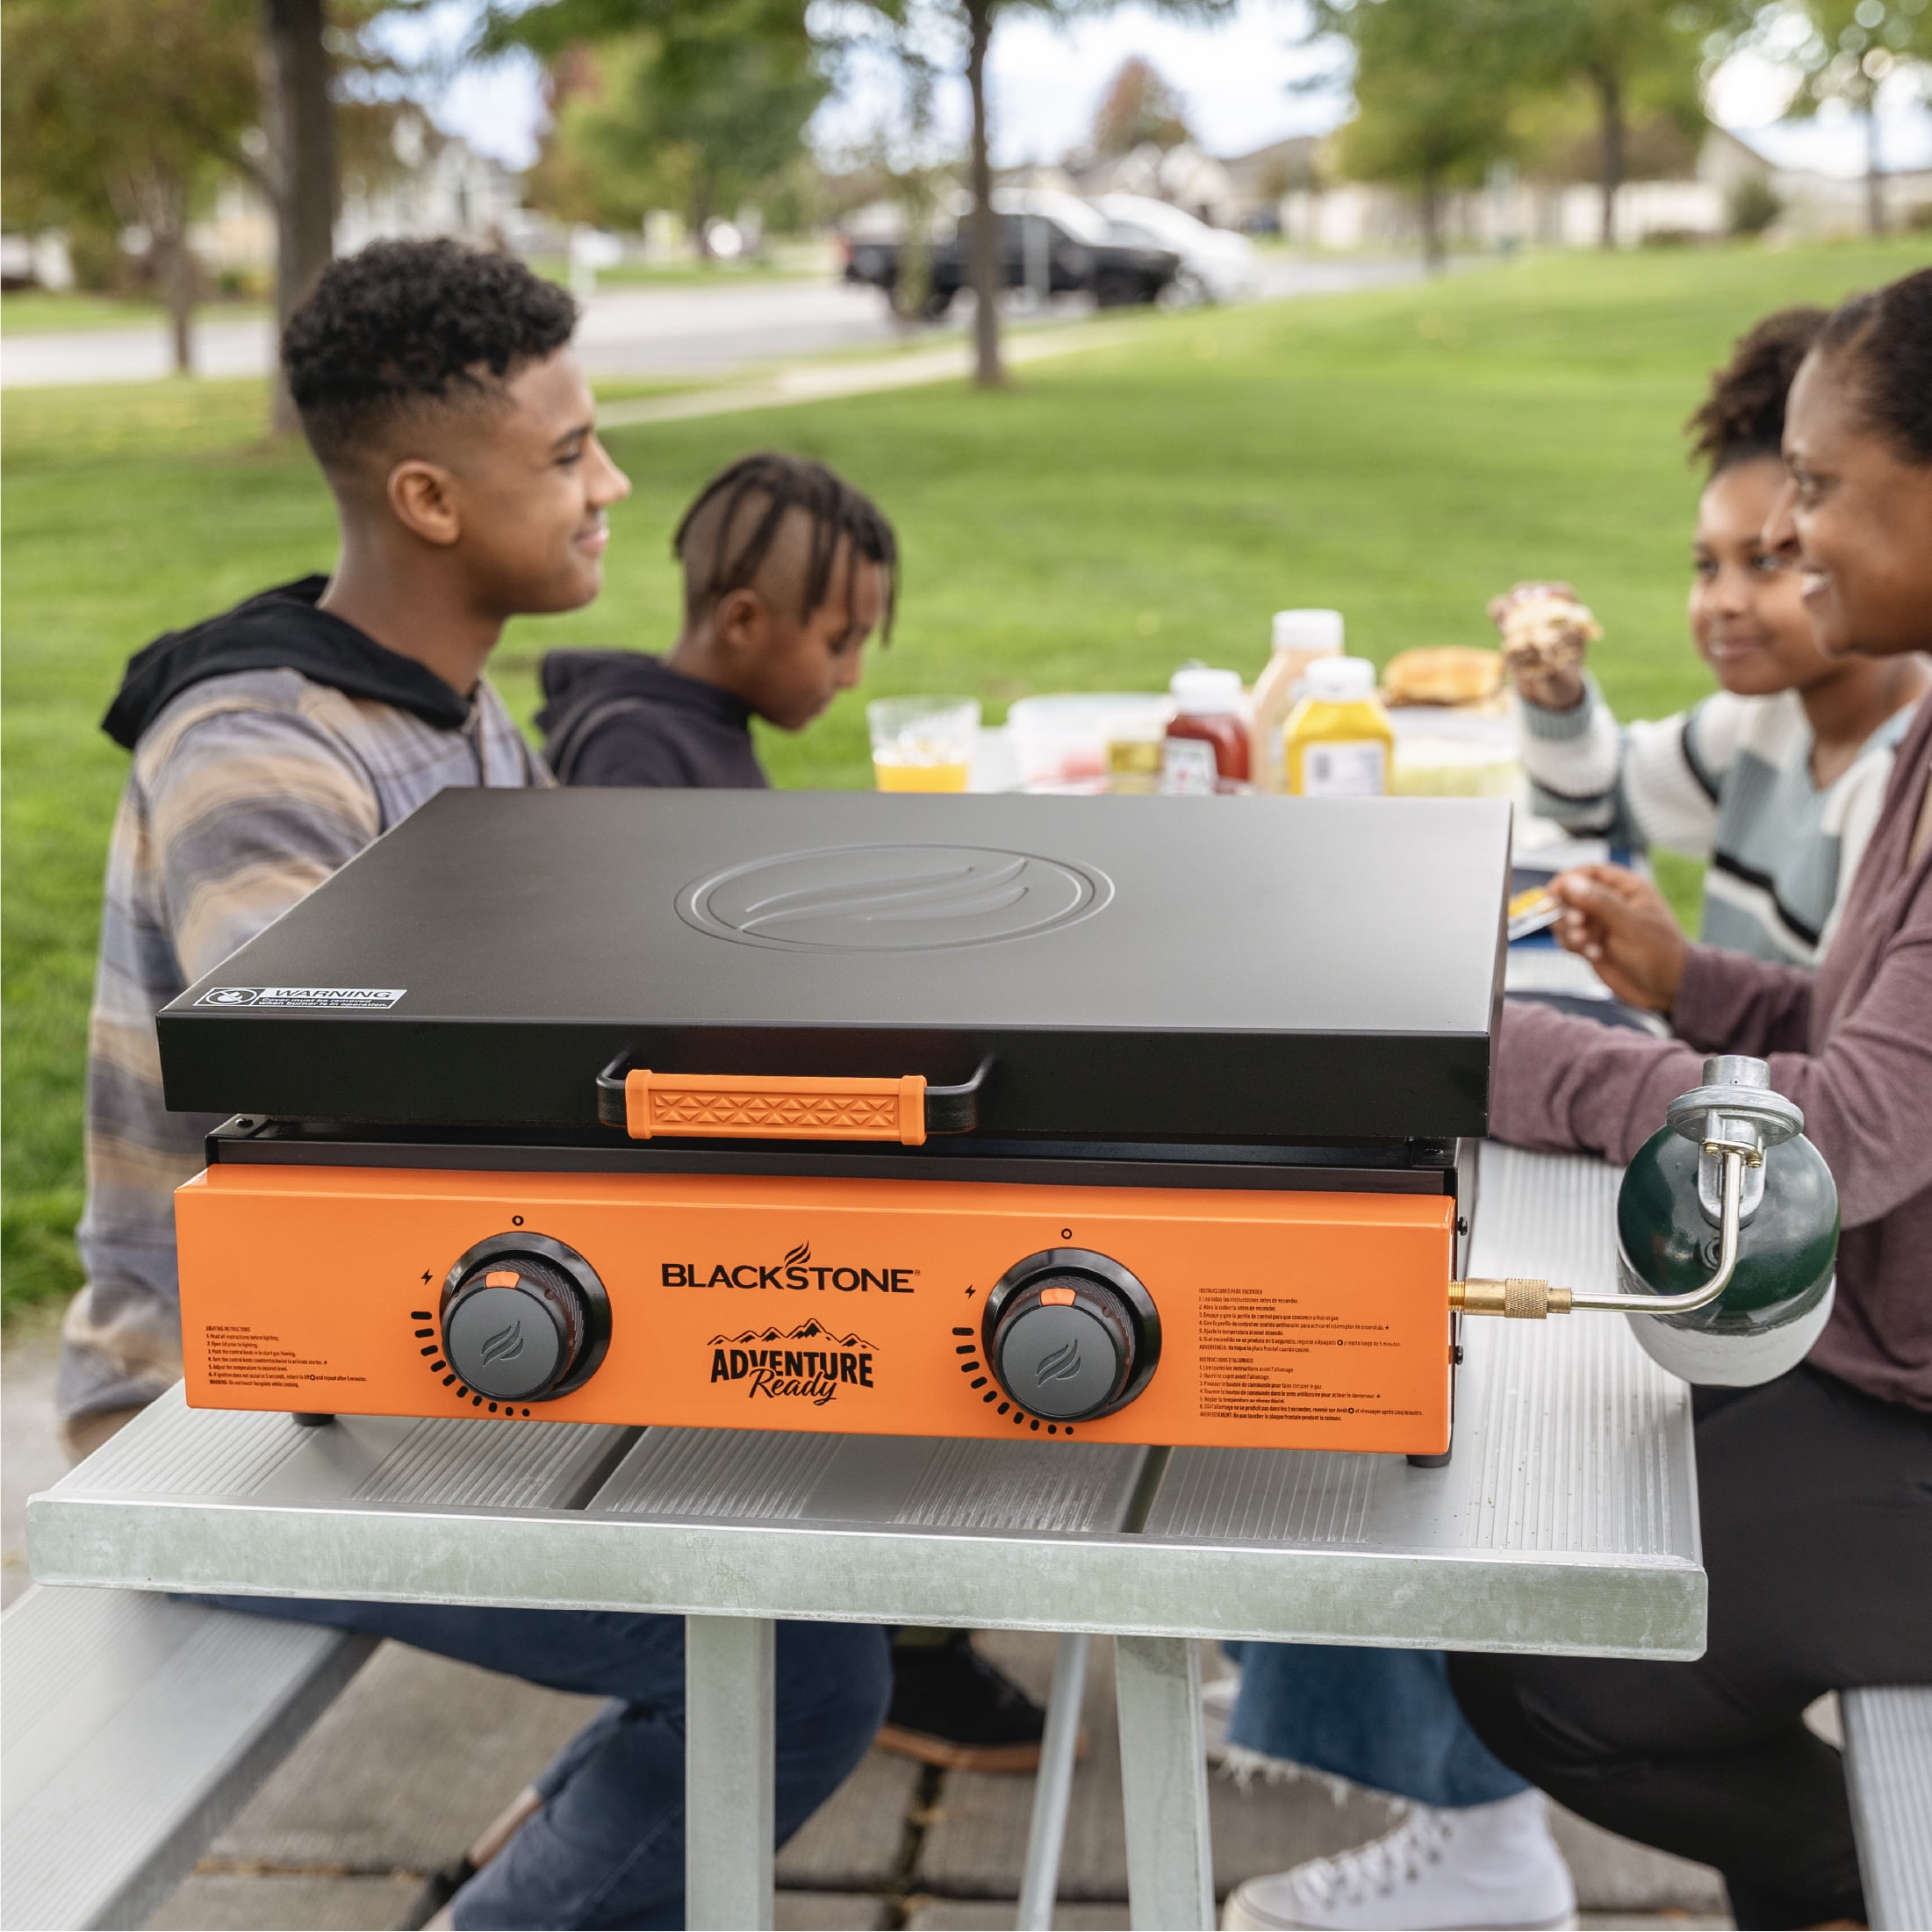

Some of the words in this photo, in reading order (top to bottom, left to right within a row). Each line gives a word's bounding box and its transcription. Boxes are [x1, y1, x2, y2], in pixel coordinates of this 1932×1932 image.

[275, 989, 392, 999] WARNING
[662, 1262, 915, 1294] BLACKSTONE
[710, 1348, 874, 1389] ADVENTURE
[748, 1368, 837, 1406] Ready
